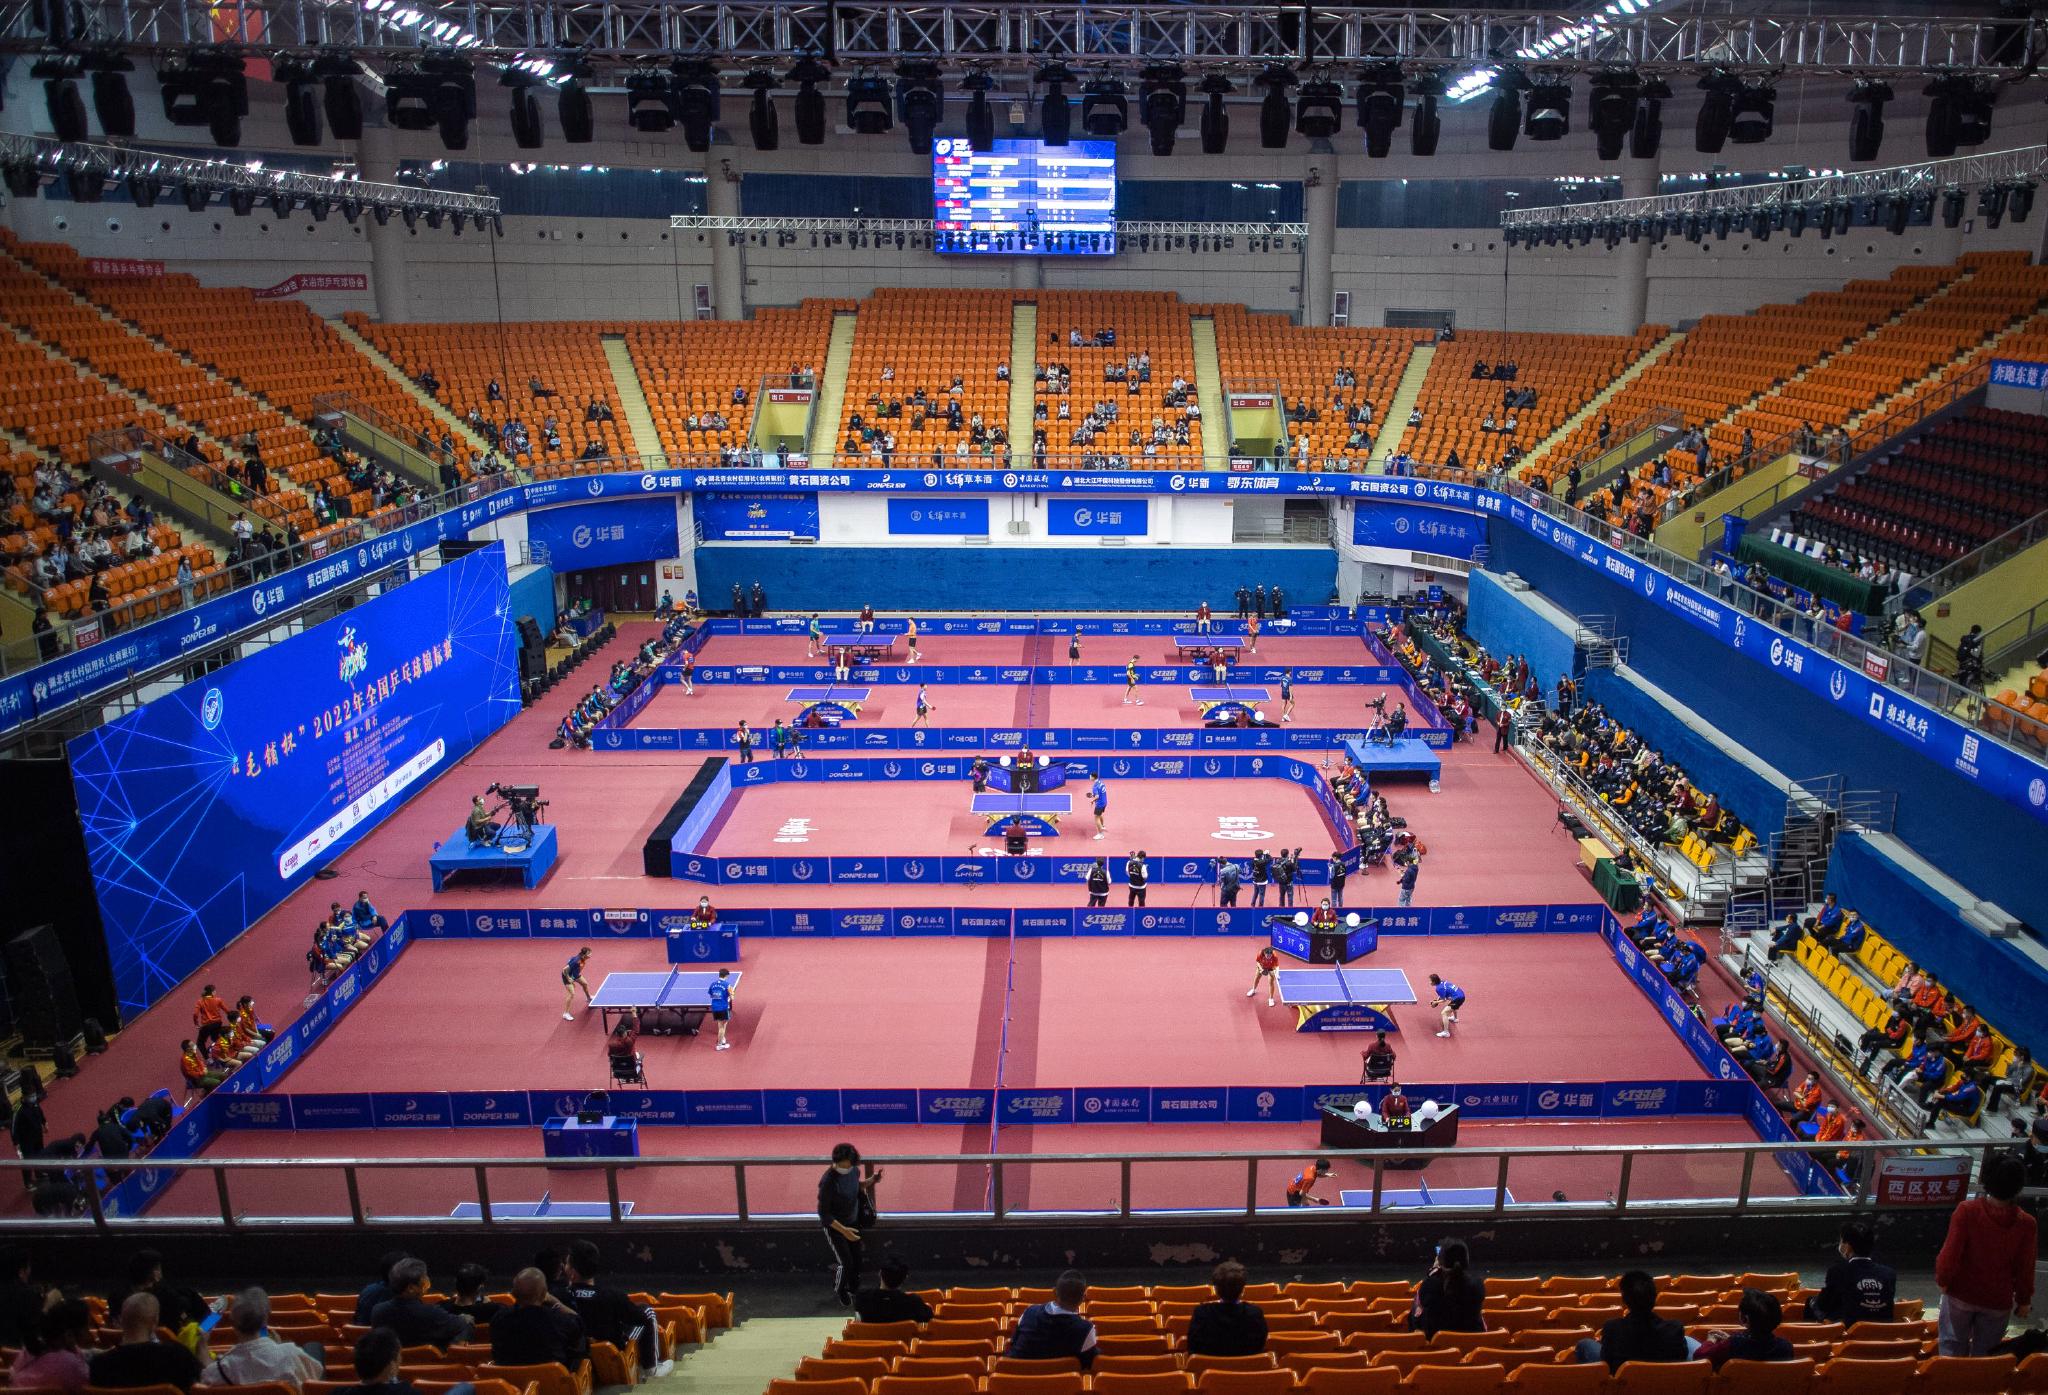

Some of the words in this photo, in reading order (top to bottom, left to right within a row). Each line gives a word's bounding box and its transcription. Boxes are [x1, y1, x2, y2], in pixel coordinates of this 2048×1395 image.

[1993, 364, 2039, 387] 奔跑东楚
[660, 476, 682, 488] 华新
[789, 475, 850, 486] 黄石国资公司
[945, 473, 994, 488] 毛铺草本酒
[1019, 475, 1049, 483] 中国银行
[1188, 477, 1210, 489] 华新
[1226, 477, 1280, 489] 鄂东体育
[1350, 480, 1408, 495] 黄石国资公司
[1097, 512, 1122, 524] 华新
[597, 525, 625, 542] 华新
[306, 559, 350, 589] 黄石国资公司
[1605, 555, 1635, 582] 黄石国资公司
[267, 586, 285, 606] 华新
[1784, 649, 1804, 674] 华新
[715, 671, 730, 680] 华新
[938, 765, 956, 774] 华新
[745, 865, 768, 876] 华新
[496, 918, 521, 930] 华新
[841, 914, 885, 930] 红双喜
[962, 918, 1006, 926] 黄石国资公司
[1022, 918, 1067, 927] 黄石国资公司
[1082, 914, 1126, 929] 红双喜
[1494, 911, 1539, 926] 红双喜
[1482, 1095, 1518, 1104] 兴业银行
[1564, 1094, 1594, 1108] 华新
[1612, 1087, 1667, 1106] 红双喜
[929, 1097, 986, 1113] 红双喜
[1008, 1096, 1064, 1113] 红双喜
[1103, 1098, 1140, 1108] 中国银行
[1160, 1100, 1217, 1110] 黄石国资公司
[1635, 1102, 1660, 1110] DHS
[954, 1108, 980, 1118] DHS
[1032, 1108, 1059, 1116] DHS
[384, 1114, 424, 1123] DONPER
[1888, 1178, 1961, 1195] 西区双号
